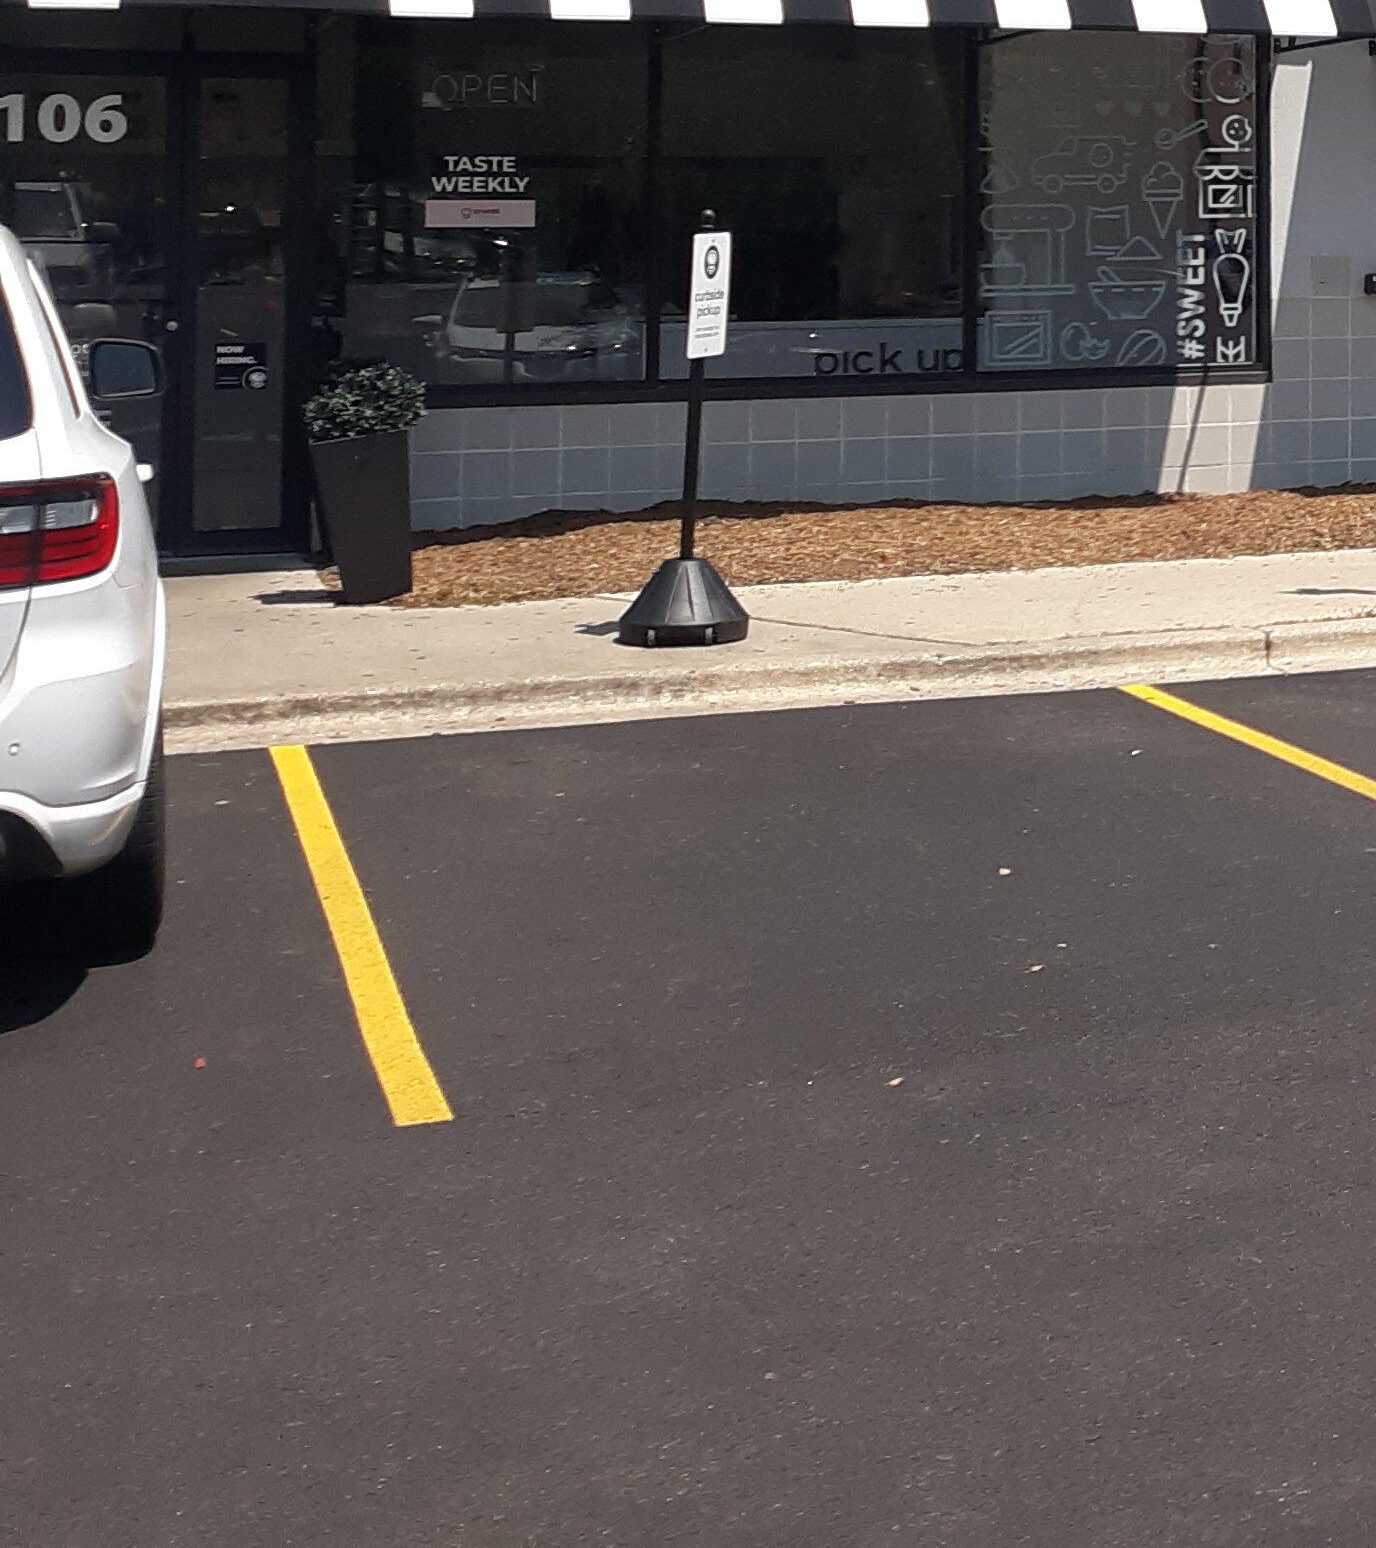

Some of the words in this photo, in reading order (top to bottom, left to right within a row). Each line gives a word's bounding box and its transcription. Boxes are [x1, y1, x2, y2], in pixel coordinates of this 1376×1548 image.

[433, 73, 538, 104] OPEN
[0, 93, 129, 143] 106
[443, 155, 517, 173] TASTE
[431, 176, 530, 193] WEEKLY
[1176, 229, 1207, 362] #SWEET
[216, 345, 246, 354] NOW
[815, 340, 903, 375] pick
[917, 348, 964, 373] up
